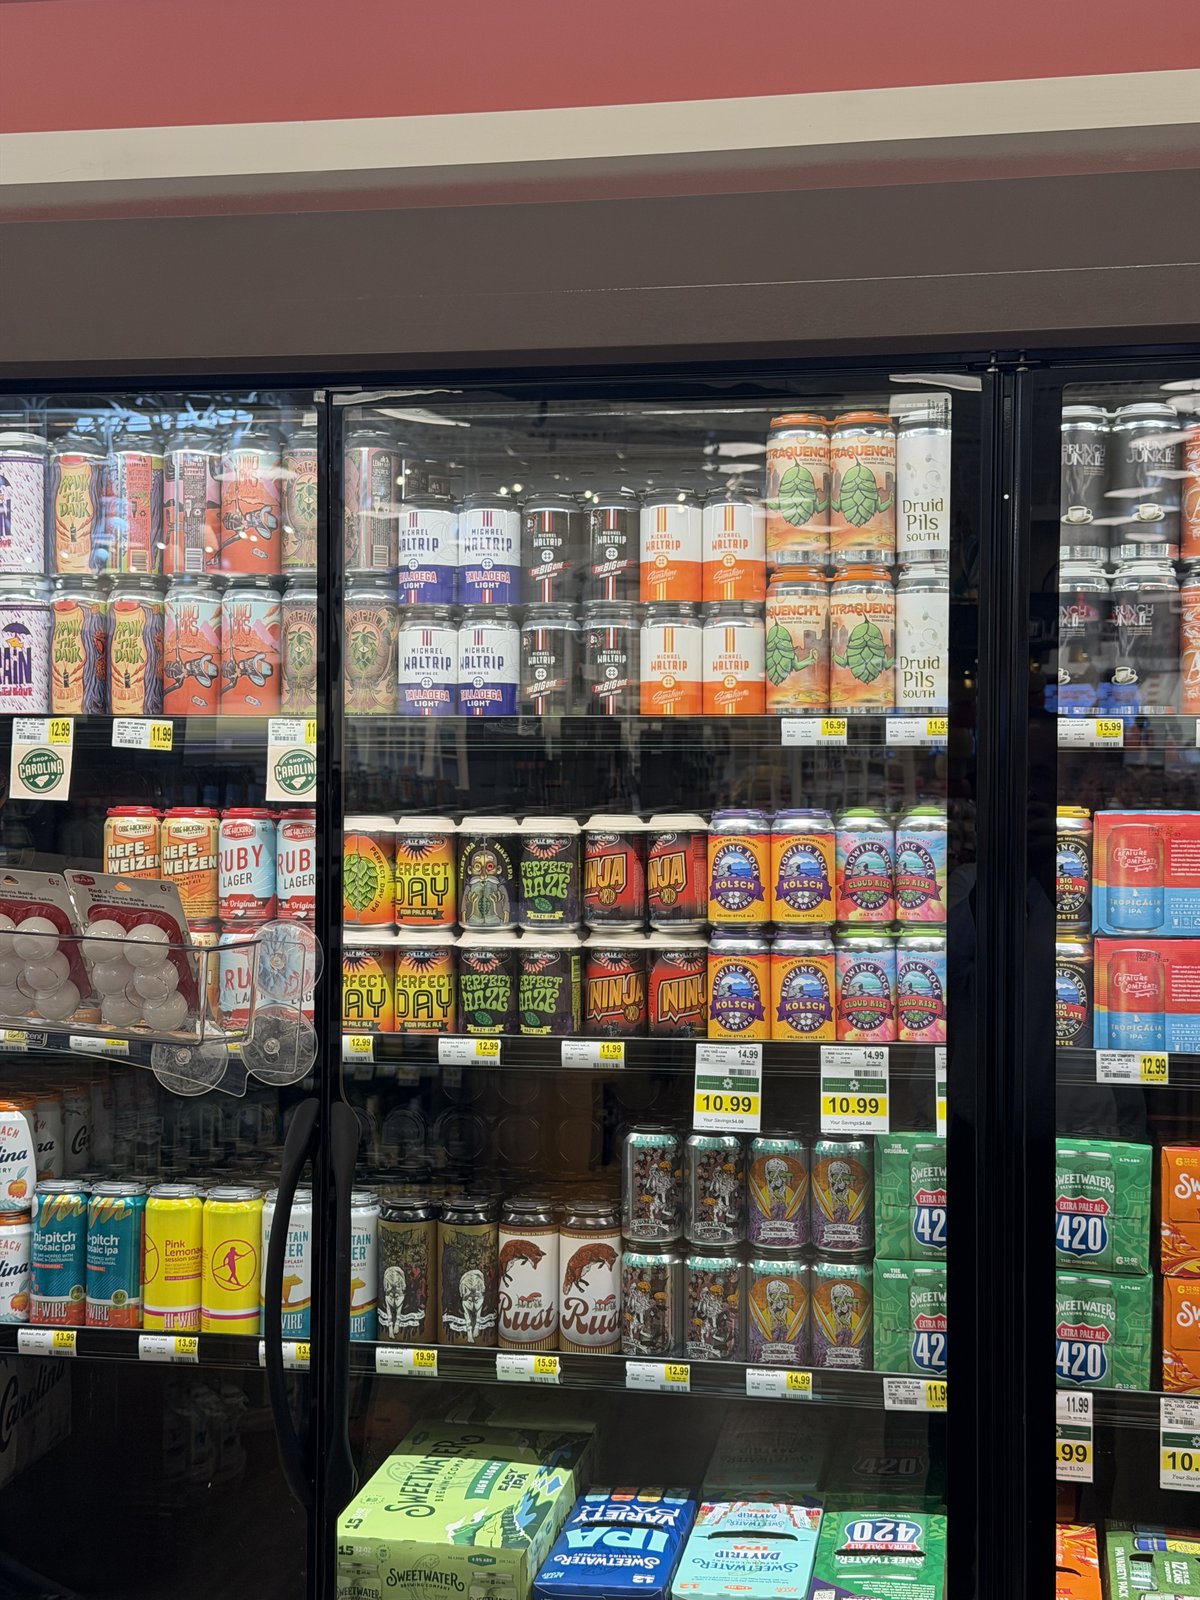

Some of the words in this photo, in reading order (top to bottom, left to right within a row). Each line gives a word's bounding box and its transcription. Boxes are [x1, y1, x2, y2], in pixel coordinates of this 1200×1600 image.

[902, 498, 944, 514] Druid
[907, 514, 939, 531] Pils
[471, 528, 503, 539] MICHAEL
[905, 532, 940, 543] SOUTH
[464, 538, 512, 554] WALTRIP
[645, 538, 681, 552] WALTRIP
[711, 538, 749, 552] WALTRIP
[540, 562, 553, 573] BIG
[603, 561, 617, 572] BIG
[403, 581, 424, 592] LIGHT
[475, 581, 499, 592] LIGHT
[411, 646, 443, 656] MICHAEL
[404, 655, 452, 672] WALTRIP
[650, 659, 688, 672] WALTRIP
[712, 659, 750, 672] WALTRIP
[900, 655, 940, 671] Druid
[534, 680, 546, 691] BIG
[603, 680, 617, 691] BIG
[904, 671, 935, 688] Pils
[902, 690, 936, 699] SOUTH
[414, 699, 440, 709] LIGHT
[467, 699, 490, 709] LIGHT
[51, 722, 70, 737] 12.99
[825, 720, 845, 730] 16.99
[1098, 722, 1121, 731] 15.99
[152, 728, 172, 744] 11.99
[32, 756, 48, 766] SHOP
[289, 757, 305, 766] SHOP
[18, 760, 64, 780] CAROLINA
[106, 841, 150, 860] HEFE-
[163, 841, 203, 861] HEFE-
[1113, 848, 1148, 862] CREATURE
[219, 843, 264, 873] RUBY
[712, 844, 744, 876] BLOWING
[744, 851, 760, 877] ROCK
[779, 844, 812, 876] BLOWING
[813, 851, 829, 877] ROCK
[845, 843, 880, 875] BLOWING
[881, 848, 893, 875] ROCK
[918, 848, 935, 877] ROCK
[1077, 848, 1090, 877] ROCK
[107, 856, 161, 875] WEIZEN
[163, 855, 217, 876] WEIZEN
[520, 860, 574, 877] PERFECT
[48, 878, 55, 886] 6
[222, 872, 253, 889] LAGER
[522, 873, 571, 899] HAZE
[715, 879, 755, 891] KÖLSCH
[783, 879, 824, 891] KÖLSCH
[848, 879, 873, 890] CLOUD
[912, 879, 930, 890] RISE
[160, 884, 167, 892] 6
[395, 876, 450, 909] DAY
[717, 895, 753, 911] BREWING
[785, 895, 822, 911] BREWING
[852, 895, 888, 910] BREWING
[396, 973, 453, 989] PERFECT
[460, 974, 513, 990] PERFECT
[712, 965, 744, 996] BLOWING
[744, 971, 760, 998] ROCK
[781, 965, 813, 997] BLOWING
[816, 972, 830, 998] ROCK
[842, 964, 874, 996] BLOWING
[876, 969, 890, 997] ROCK
[928, 970, 942, 997] ROCK
[1114, 973, 1149, 986] CREATURE
[588, 971, 645, 1013] NINJA
[1071, 976, 1088, 1004] ROCK
[345, 988, 387, 1019] AY
[397, 988, 453, 1019] DAY
[462, 986, 511, 1012] HAZE
[715, 999, 755, 1011] KÖLSCH
[785, 999, 826, 1012] KÖLSCH
[844, 1000, 869, 1011] CLOUD
[869, 1000, 888, 1010] RISE
[918, 1000, 938, 1011] RISE
[430, 1021, 442, 1030] ALE
[717, 1015, 754, 1031] BREWING
[787, 1016, 824, 1032] BREWING
[847, 1015, 885, 1030] BREWING
[1111, 1023, 1162, 1033] TROPICÁLIA
[351, 1038, 371, 1047] 12.99
[478, 1041, 499, 1051] 12.99
[601, 1044, 622, 1053] 11.99
[737, 1049, 759, 1060] 14.99
[863, 1050, 885, 1060] 14.99
[1143, 1058, 1167, 1075] 12.99
[701, 1094, 752, 1114] 10.99
[828, 1096, 880, 1115] 10.99
[883, 1147, 909, 1155] ORIGINAL
[1175, 1158, 1184, 1168] 6
[919, 1194, 937, 1205] EXTRA
[1059, 1201, 1077, 1212] EXTRA
[1078, 1203, 1094, 1214] PALE
[1093, 1204, 1106, 1215] ALE
[916, 1207, 947, 1242] 42
[34, 1230, 77, 1246] hi-pitch
[1056, 1215, 1103, 1252] 420
[33, 1243, 60, 1255] mosaic
[61, 1243, 77, 1254] ipa
[165, 1239, 186, 1249] Pink
[104, 1246, 119, 1257] ipa
[164, 1256, 188, 1265] session
[1115, 1256, 1124, 1267] 6
[882, 1272, 909, 1280] ORIGINAL
[1177, 1286, 1185, 1295] 6
[498, 1290, 556, 1332] Rust
[919, 1317, 936, 1330] EXTRA
[56, 1333, 75, 1345] 13.99
[1060, 1327, 1078, 1339] EXTRA
[1079, 1329, 1094, 1341] PALE
[1094, 1330, 1106, 1341] ALE
[177, 1338, 197, 1349] 13.99
[916, 1332, 946, 1367] 42
[415, 1352, 436, 1363] 19.99
[537, 1358, 558, 1370] 15.99
[1056, 1341, 1102, 1379] 420
[668, 1366, 689, 1377] 12.99
[789, 1374, 811, 1387] 14.99
[1066, 1396, 1089, 1415] 11.99
[858, 1456, 917, 1475] 420
[1069, 1466, 1084, 1474] $1.00
[384, 1435, 486, 1519] SWEETWATER
[497, 1467, 517, 1492] EASY
[510, 1471, 530, 1489] IPA
[1172, 1473, 1184, 1481] Your
[474, 1478, 493, 1495] HIGH
[580, 1503, 681, 1518] PACK
[737, 1511, 778, 1521] DAYTRIP
[344, 1516, 364, 1530] 15
[572, 1511, 676, 1529] VARIETY
[565, 1526, 670, 1553] IPA
[853, 1521, 916, 1544] 420
[338, 1546, 354, 1556] 15
[714, 1550, 782, 1563] DAYTRIP
[553, 1554, 661, 1570] SWEETWATER
[691, 1557, 799, 1576] SWEETWATER
[835, 1554, 925, 1568] SWEETWATER
[1116, 1557, 1128, 1581] VARIETY
[386, 1567, 466, 1595] SWEETWATER
[632, 1575, 655, 1584] 12
[424, 1584, 451, 1594] COMPANY
[1118, 1581, 1130, 1598] PACK
